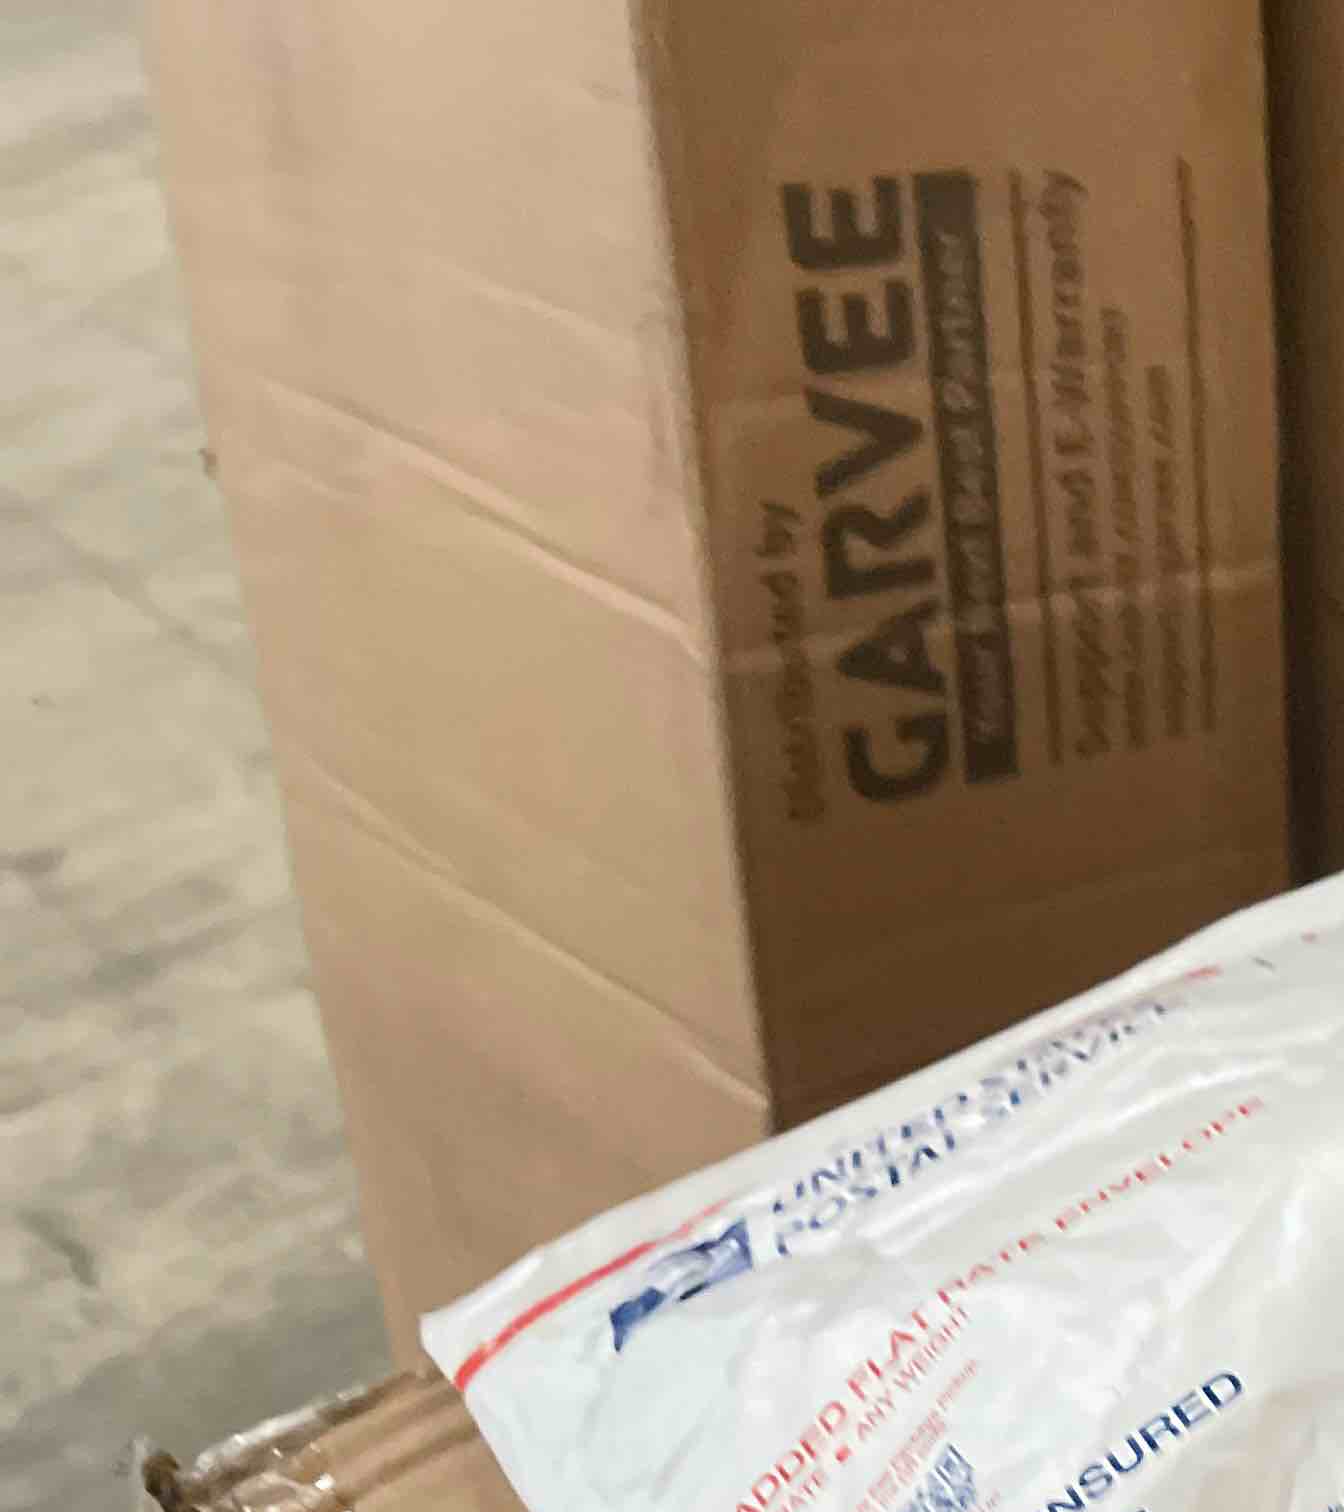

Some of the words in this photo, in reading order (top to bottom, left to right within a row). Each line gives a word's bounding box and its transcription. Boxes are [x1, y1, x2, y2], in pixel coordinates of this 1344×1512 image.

[781, 174, 950, 802] GARVEE
[845, 1303, 932, 1402] FLAT
[934, 1225, 1046, 1309] RATE
[1051, 1090, 1266, 1233] ENVELOPE
[851, 1385, 896, 1443] ANY
[891, 1303, 971, 1394] WEIGHT
